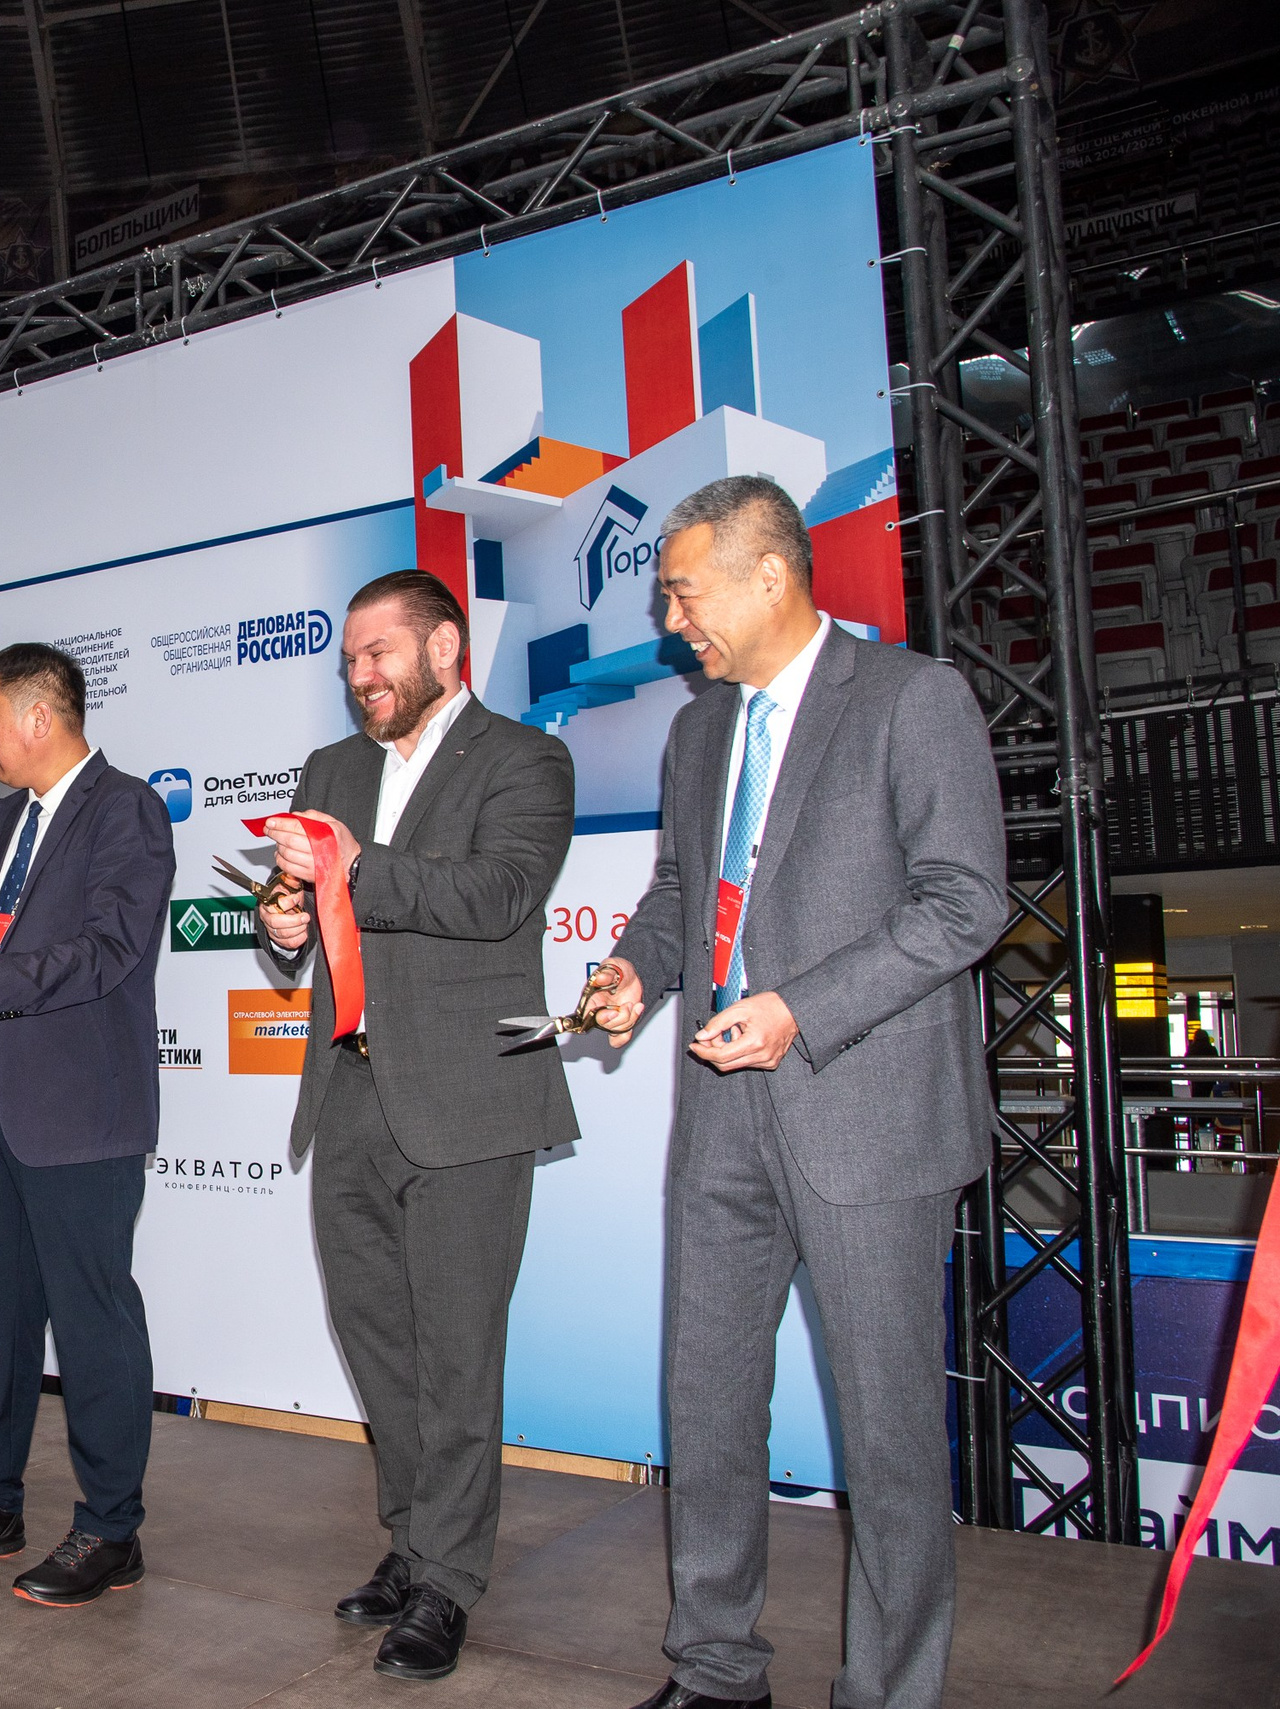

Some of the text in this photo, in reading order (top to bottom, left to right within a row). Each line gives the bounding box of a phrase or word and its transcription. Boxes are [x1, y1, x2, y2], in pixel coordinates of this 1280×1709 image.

[1172, 91, 1250, 126] ОККЕЙНОЙ
[76, 192, 199, 260] БОЛЕЛЬЩИКИ
[54, 628, 122, 647] НАЦИОНАЛЬНОЕ
[151, 624, 231, 648] ОБЩЕРОССИЙСКАЯ
[237, 611, 305, 642] ДЕЛОВАЯ
[63, 641, 114, 657] ЪЕДИНЕНИЕ
[163, 640, 231, 662] ОБЩЕСТВЕННАЯ
[237, 632, 306, 666] РОССИЯ
[170, 656, 232, 676] ОРГАНИЗАЦИЯ
[204, 788, 296, 808] для бизнес
[233, 1010, 275, 1019] ОТРАСЛЕВОЙ
[156, 1157, 283, 1181] ЭКВАТОР
[164, 1181, 274, 1196] КОНФЕРЕНЦ-ОТЕЛЬ
